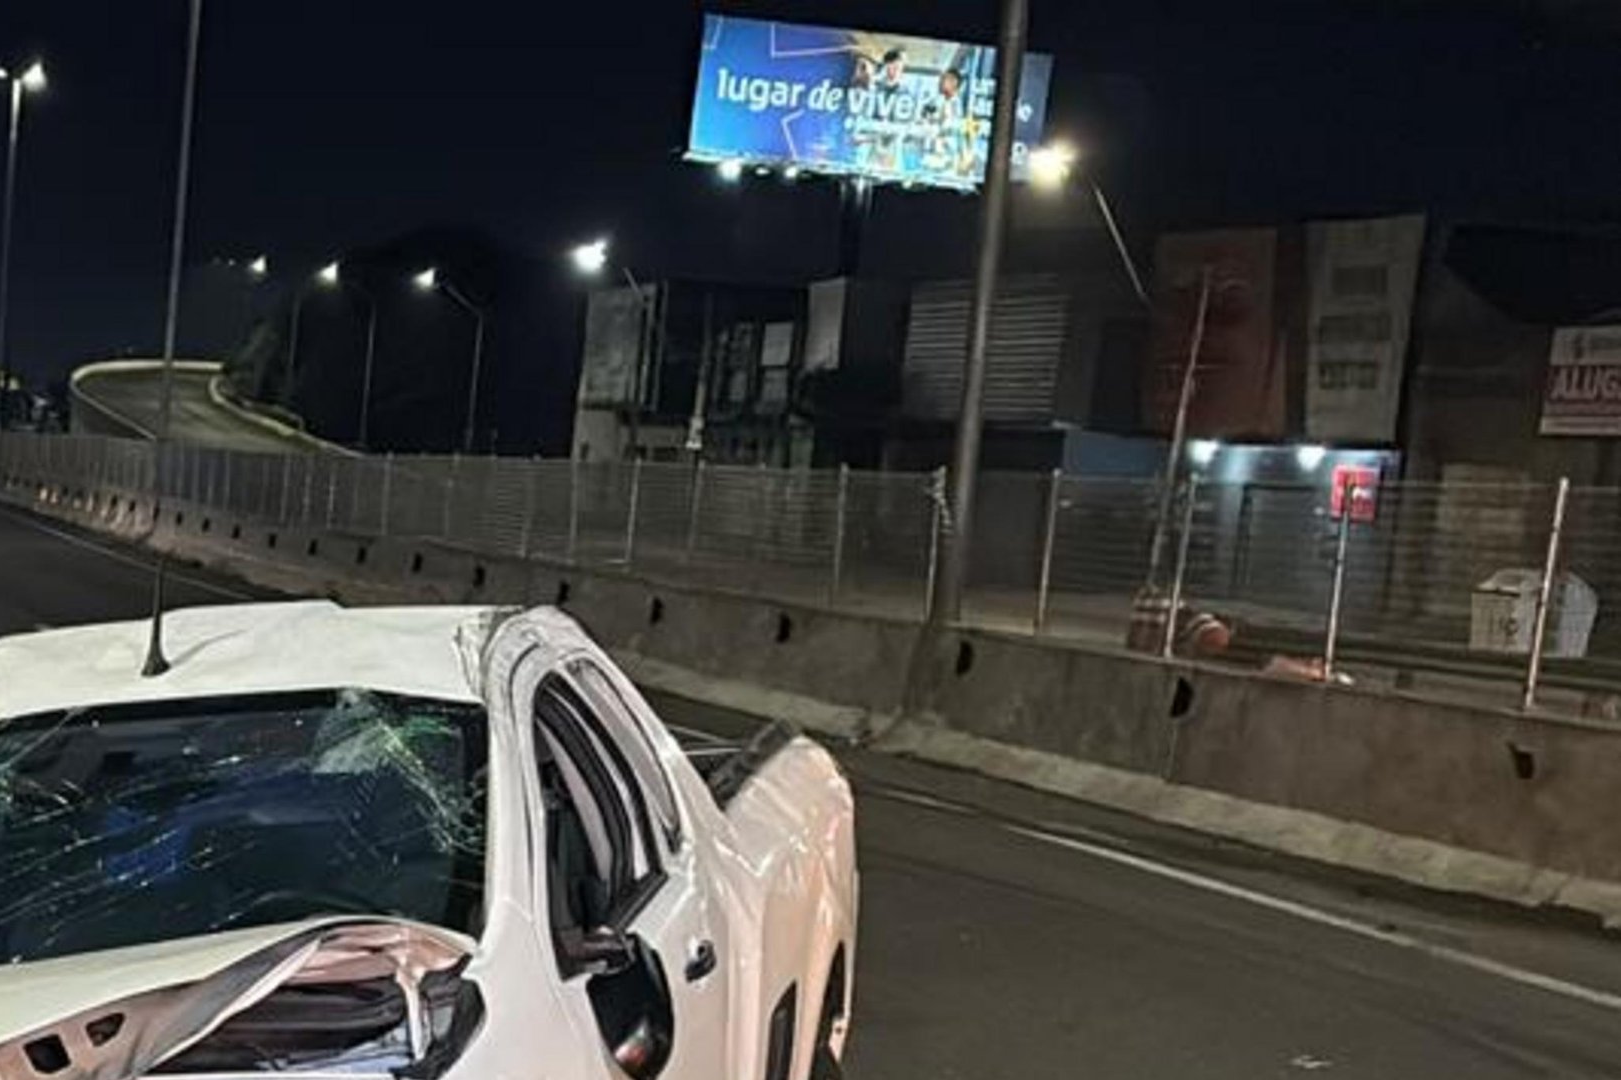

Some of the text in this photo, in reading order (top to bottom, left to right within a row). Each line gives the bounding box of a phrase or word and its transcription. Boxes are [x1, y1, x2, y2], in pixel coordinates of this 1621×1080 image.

[716, 67, 805, 112] lugar
[808, 79, 844, 112] de
[1550, 366, 1621, 400] ALUG
